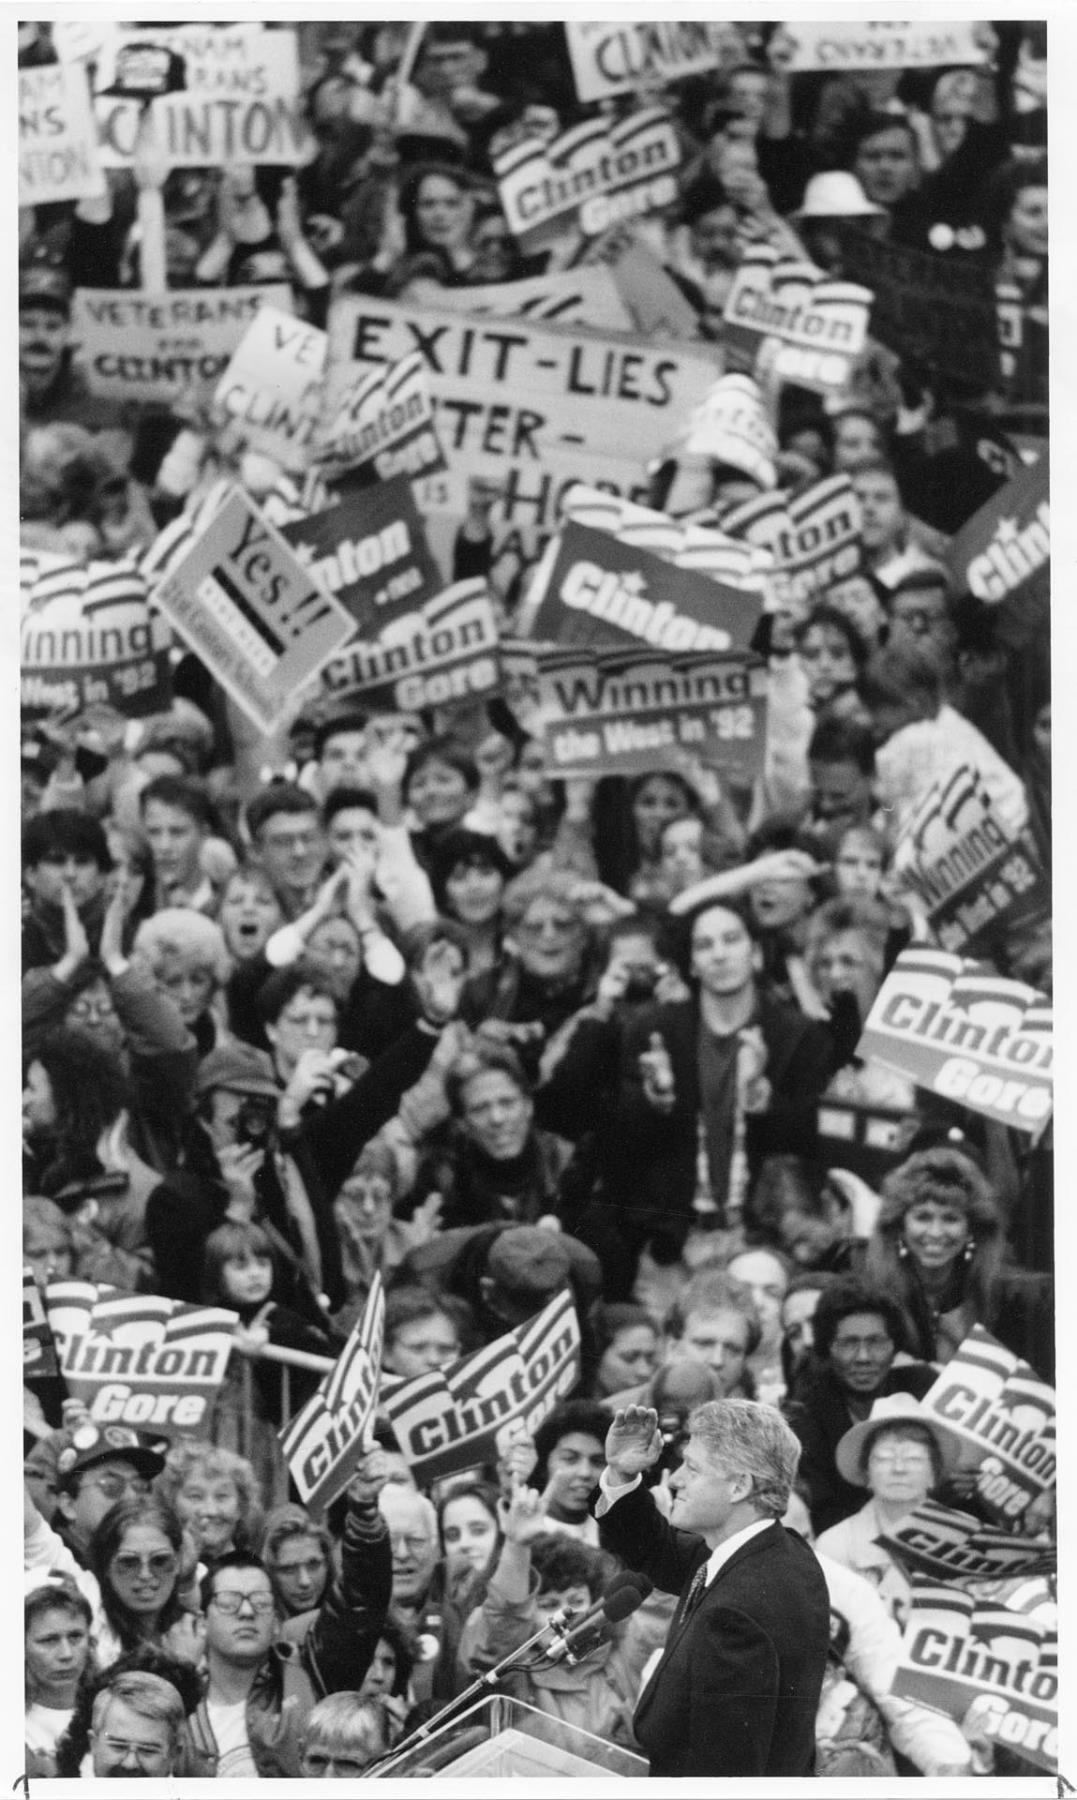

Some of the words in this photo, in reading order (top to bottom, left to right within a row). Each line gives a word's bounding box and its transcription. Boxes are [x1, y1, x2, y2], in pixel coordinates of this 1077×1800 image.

[516, 141, 665, 220] Clinton
[734, 286, 851, 342] Clinton
[560, 560, 732, 651] Clinton
[320, 618, 486, 693] Clinton
[395, 658, 496, 711] Gore
[552, 673, 751, 715] Winning
[933, 1056, 1053, 1119] Gore
[90, 1383, 207, 1425] Gore
[408, 1325, 573, 1457] Clinton
